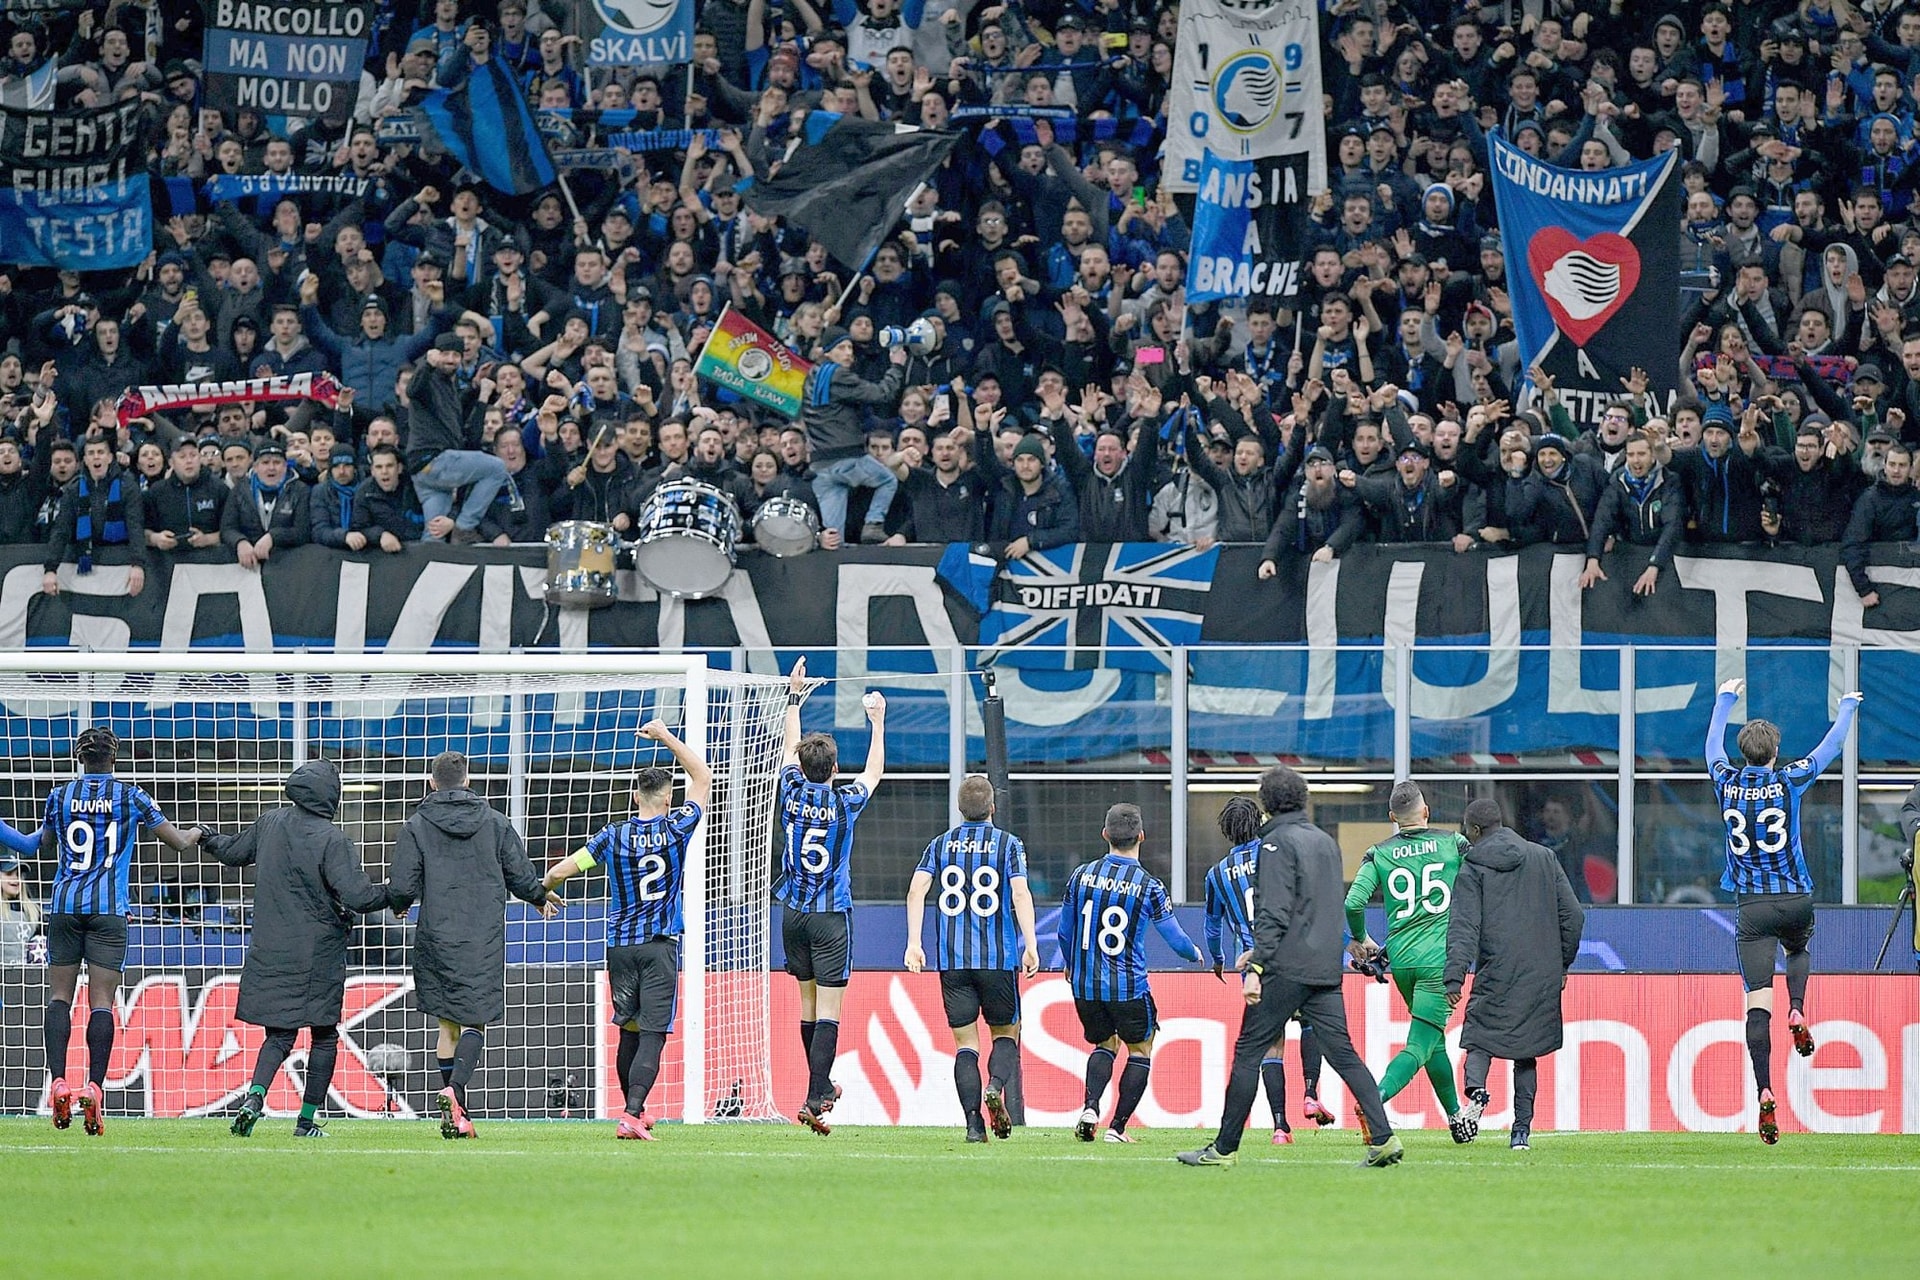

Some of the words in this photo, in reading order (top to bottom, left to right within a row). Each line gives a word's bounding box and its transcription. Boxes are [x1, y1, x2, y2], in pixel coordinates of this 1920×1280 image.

[217, 0, 364, 36] BARCOLLO
[229, 38, 268, 69] MA
[287, 43, 347, 74] NON
[590, 30, 686, 62] SKALVÌ
[237, 77, 332, 112] MOLLO
[23, 103, 139, 157] GENTE
[13, 158, 127, 206] FUORI
[277, 175, 369, 197] ATALANTA
[1495, 141, 1648, 204] CONDANNATI
[26, 207, 144, 258] TESTA
[1242, 220, 1262, 255] A
[1195, 256, 1300, 297] BRACHE
[1577, 349, 1600, 380] A
[139, 372, 312, 411] AMANTEA
[1020, 583, 1161, 608] DIFFIDATI
[70, 797, 113, 813] DUVÁN
[786, 799, 800, 815] DE
[802, 804, 836, 820] ROON
[1724, 783, 1784, 800] HATEBOER
[67, 820, 117, 870] 91
[631, 832, 667, 848] TOLOI
[786, 822, 830, 874] 15
[1724, 807, 1787, 855] 33
[1393, 840, 1437, 859] GOLLINI
[638, 854, 667, 901] 2
[1080, 872, 1141, 898] MALINOVSKYI
[1224, 860, 1256, 880] TAME
[939, 865, 999, 917] 88
[1388, 863, 1451, 919] 95
[1081, 900, 1129, 956] 18
